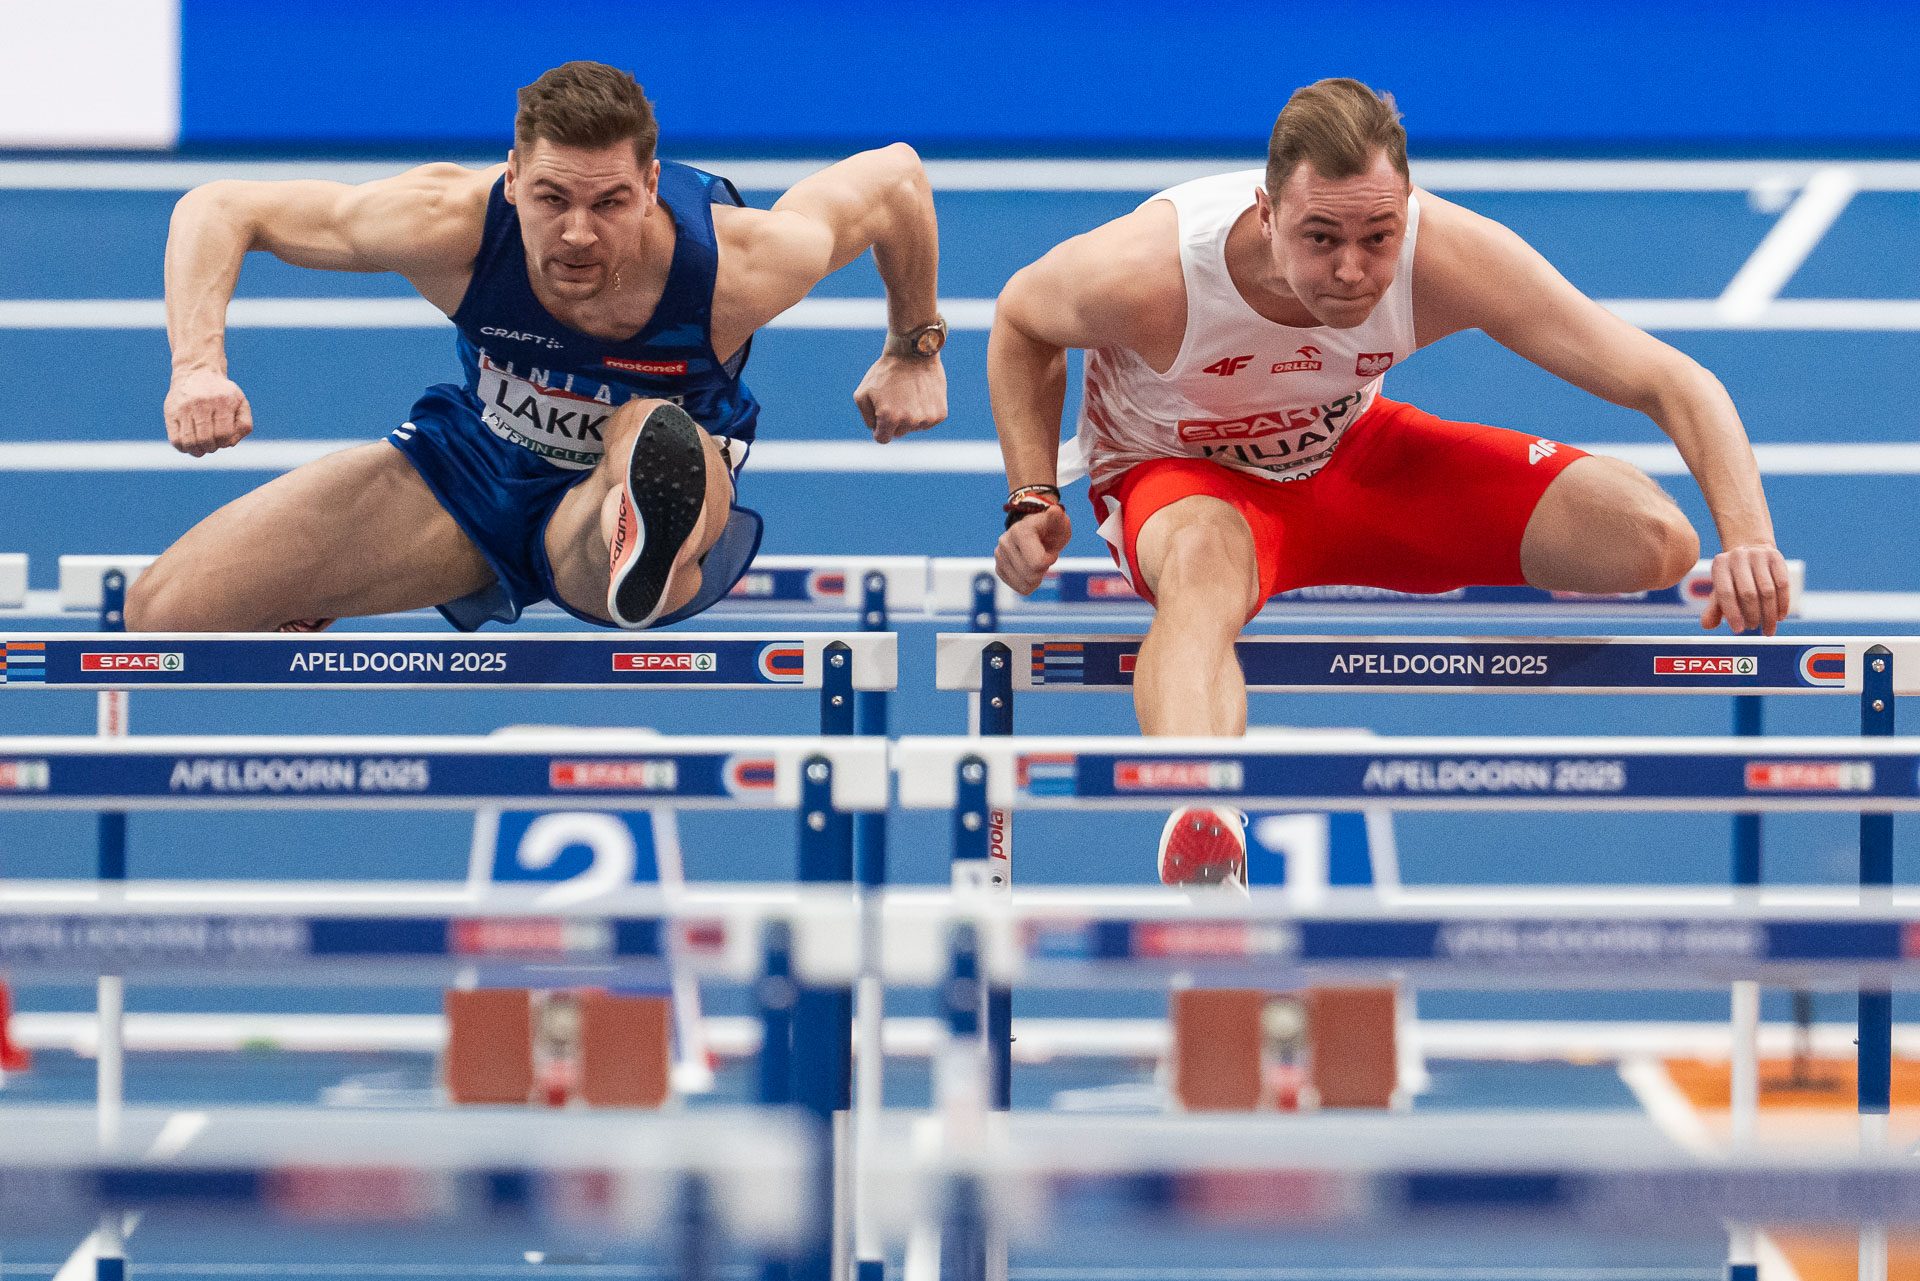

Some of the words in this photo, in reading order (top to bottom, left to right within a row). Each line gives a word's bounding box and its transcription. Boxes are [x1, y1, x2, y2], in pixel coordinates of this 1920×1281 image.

[480, 326, 547, 344] CRAFT
[606, 359, 685, 374] motonet
[1203, 355, 1254, 376] 4F
[1274, 361, 1319, 373] ORLEN
[1529, 439, 1558, 466] 4F
[100, 656, 159, 668] SPAR
[289, 652, 444, 672] APELDOORN
[450, 652, 507, 672] 2025
[631, 656, 691, 668] SPAR
[1329, 654, 1485, 674] APELDOORN
[1491, 655, 1548, 675] 2025
[1673, 660, 1732, 671] SPAR
[170, 759, 354, 791] APELDOORN
[358, 760, 430, 790] 2025
[516, 813, 638, 904] 2
[1253, 813, 1331, 906] 1
